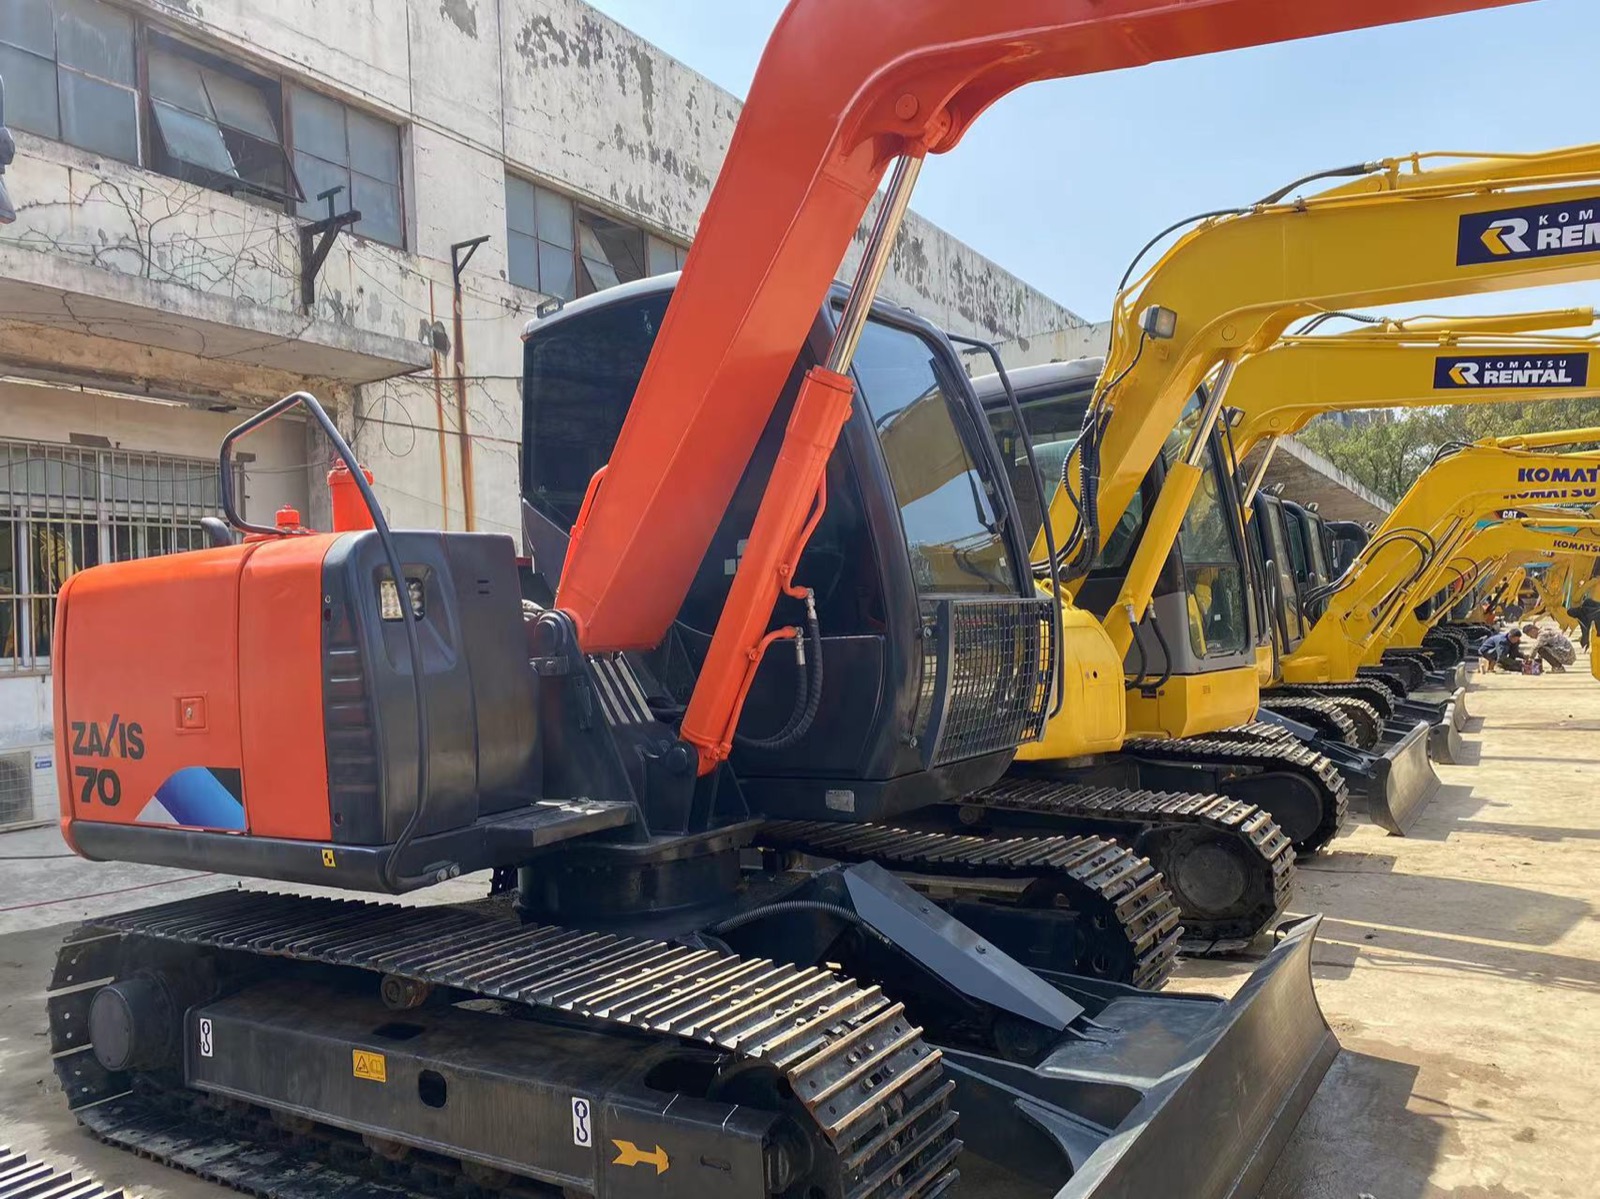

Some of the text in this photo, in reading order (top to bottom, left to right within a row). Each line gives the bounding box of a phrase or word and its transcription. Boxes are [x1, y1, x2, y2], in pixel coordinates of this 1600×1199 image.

[1538, 209, 1594, 226] KOM
[1484, 360, 1567, 369] KOMATSU
[1483, 369, 1572, 385] RENTAL
[1502, 510, 1518, 519] CAT
[1553, 539, 1600, 553] KOMATS
[71, 713, 145, 760] ZAXIS
[75, 765, 121, 807] 70
